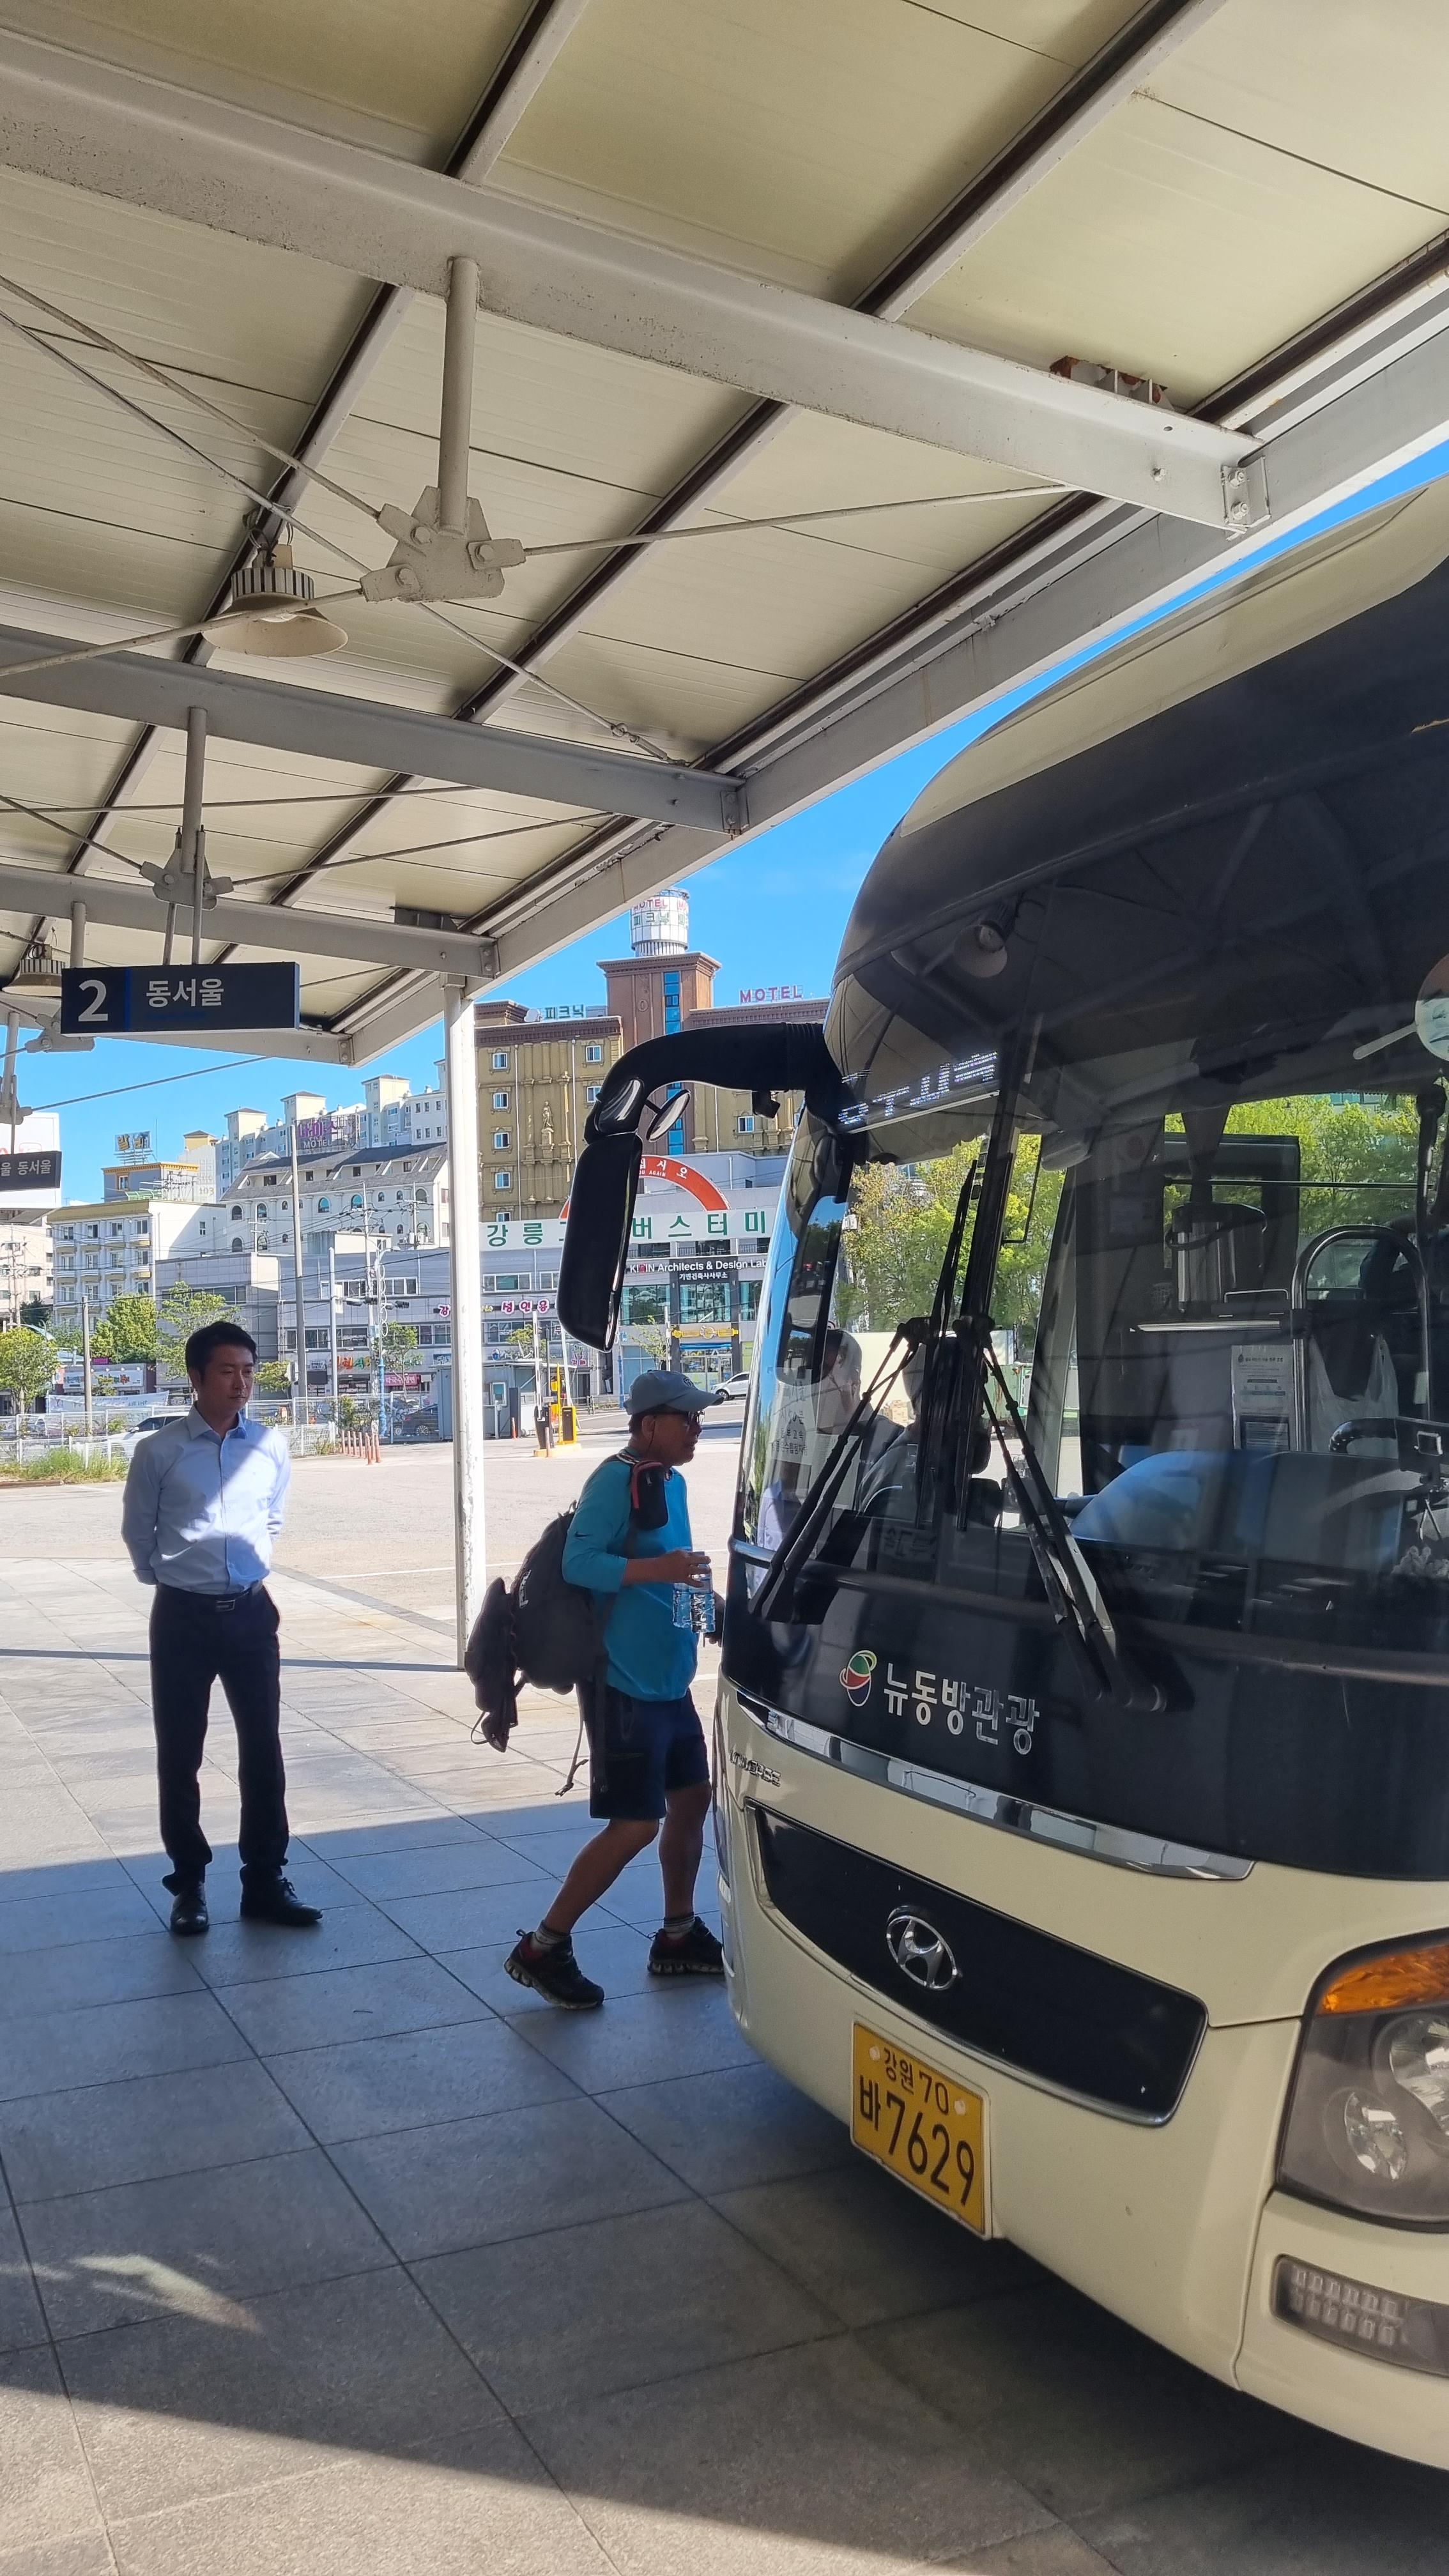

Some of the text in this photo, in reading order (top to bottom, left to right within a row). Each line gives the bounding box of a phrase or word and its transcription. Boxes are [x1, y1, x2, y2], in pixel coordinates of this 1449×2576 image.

[77, 978, 224, 1022] 2 동서울
[740, 985, 803, 1003] MOTEL
[544, 1004, 584, 1019] 피크닉
[303, 1138, 333, 1149] MOTEL
[17, 1159, 52, 1176] 동서울
[657, 1262, 704, 1272] Architects
[706, 1261, 713, 1270] &
[716, 1261, 748, 1269] Design
[502, 1299, 557, 1314] 성인용
[884, 1662, 1040, 1756] 뉴동방관광
